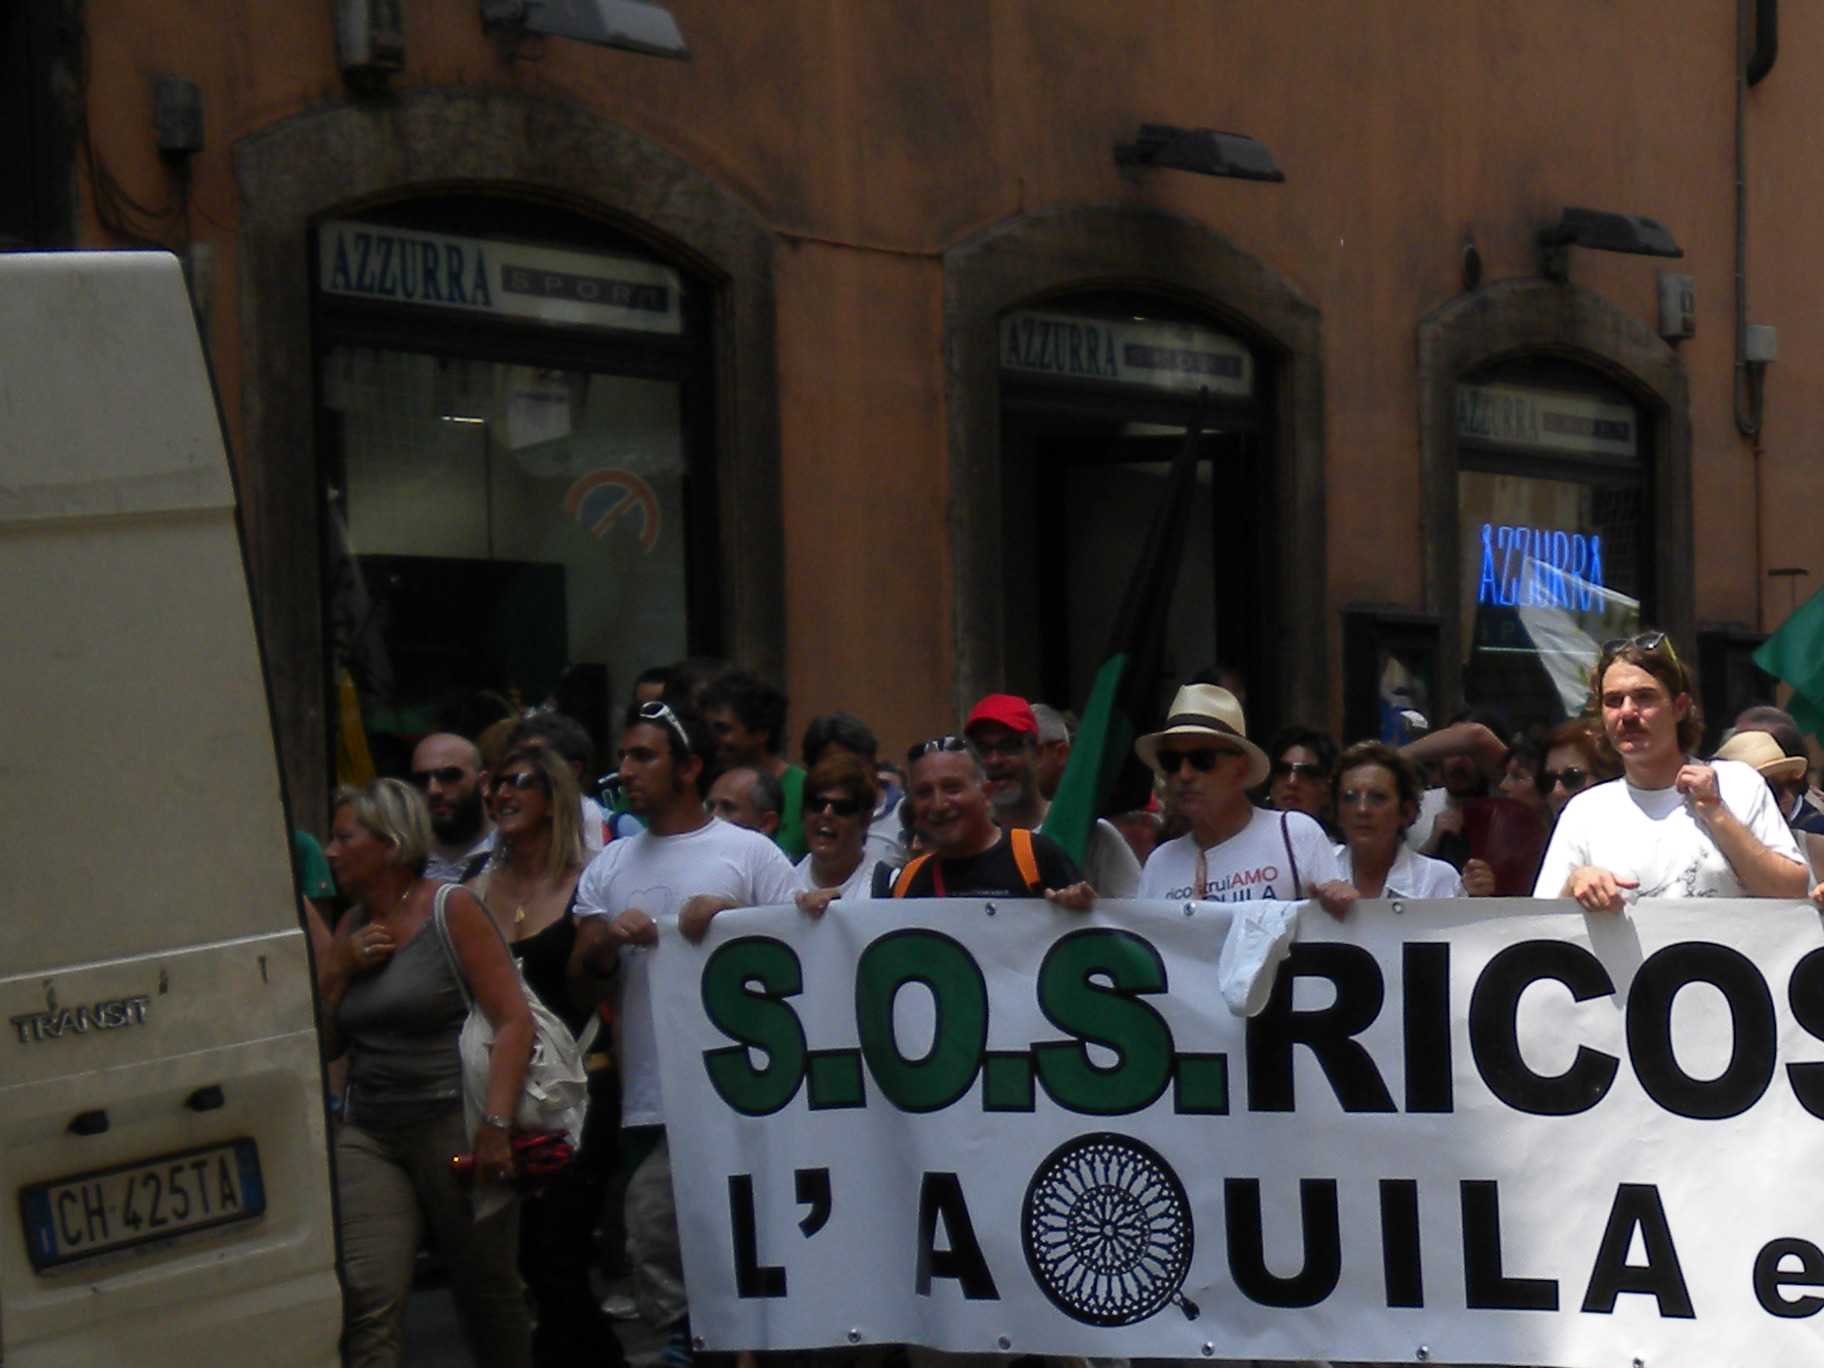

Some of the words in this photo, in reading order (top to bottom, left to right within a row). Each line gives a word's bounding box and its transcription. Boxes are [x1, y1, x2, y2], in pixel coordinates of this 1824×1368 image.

[331, 229, 493, 308] AZZURRA
[1005, 317, 1119, 378] AZZURRA
[1479, 522, 1606, 614] AZZURRA
[1165, 865, 1279, 900] ricotruiAMO
[10, 995, 152, 1044] TRANSIT
[57, 1183, 109, 1247] CH
[121, 1155, 239, 1231] 425TA
